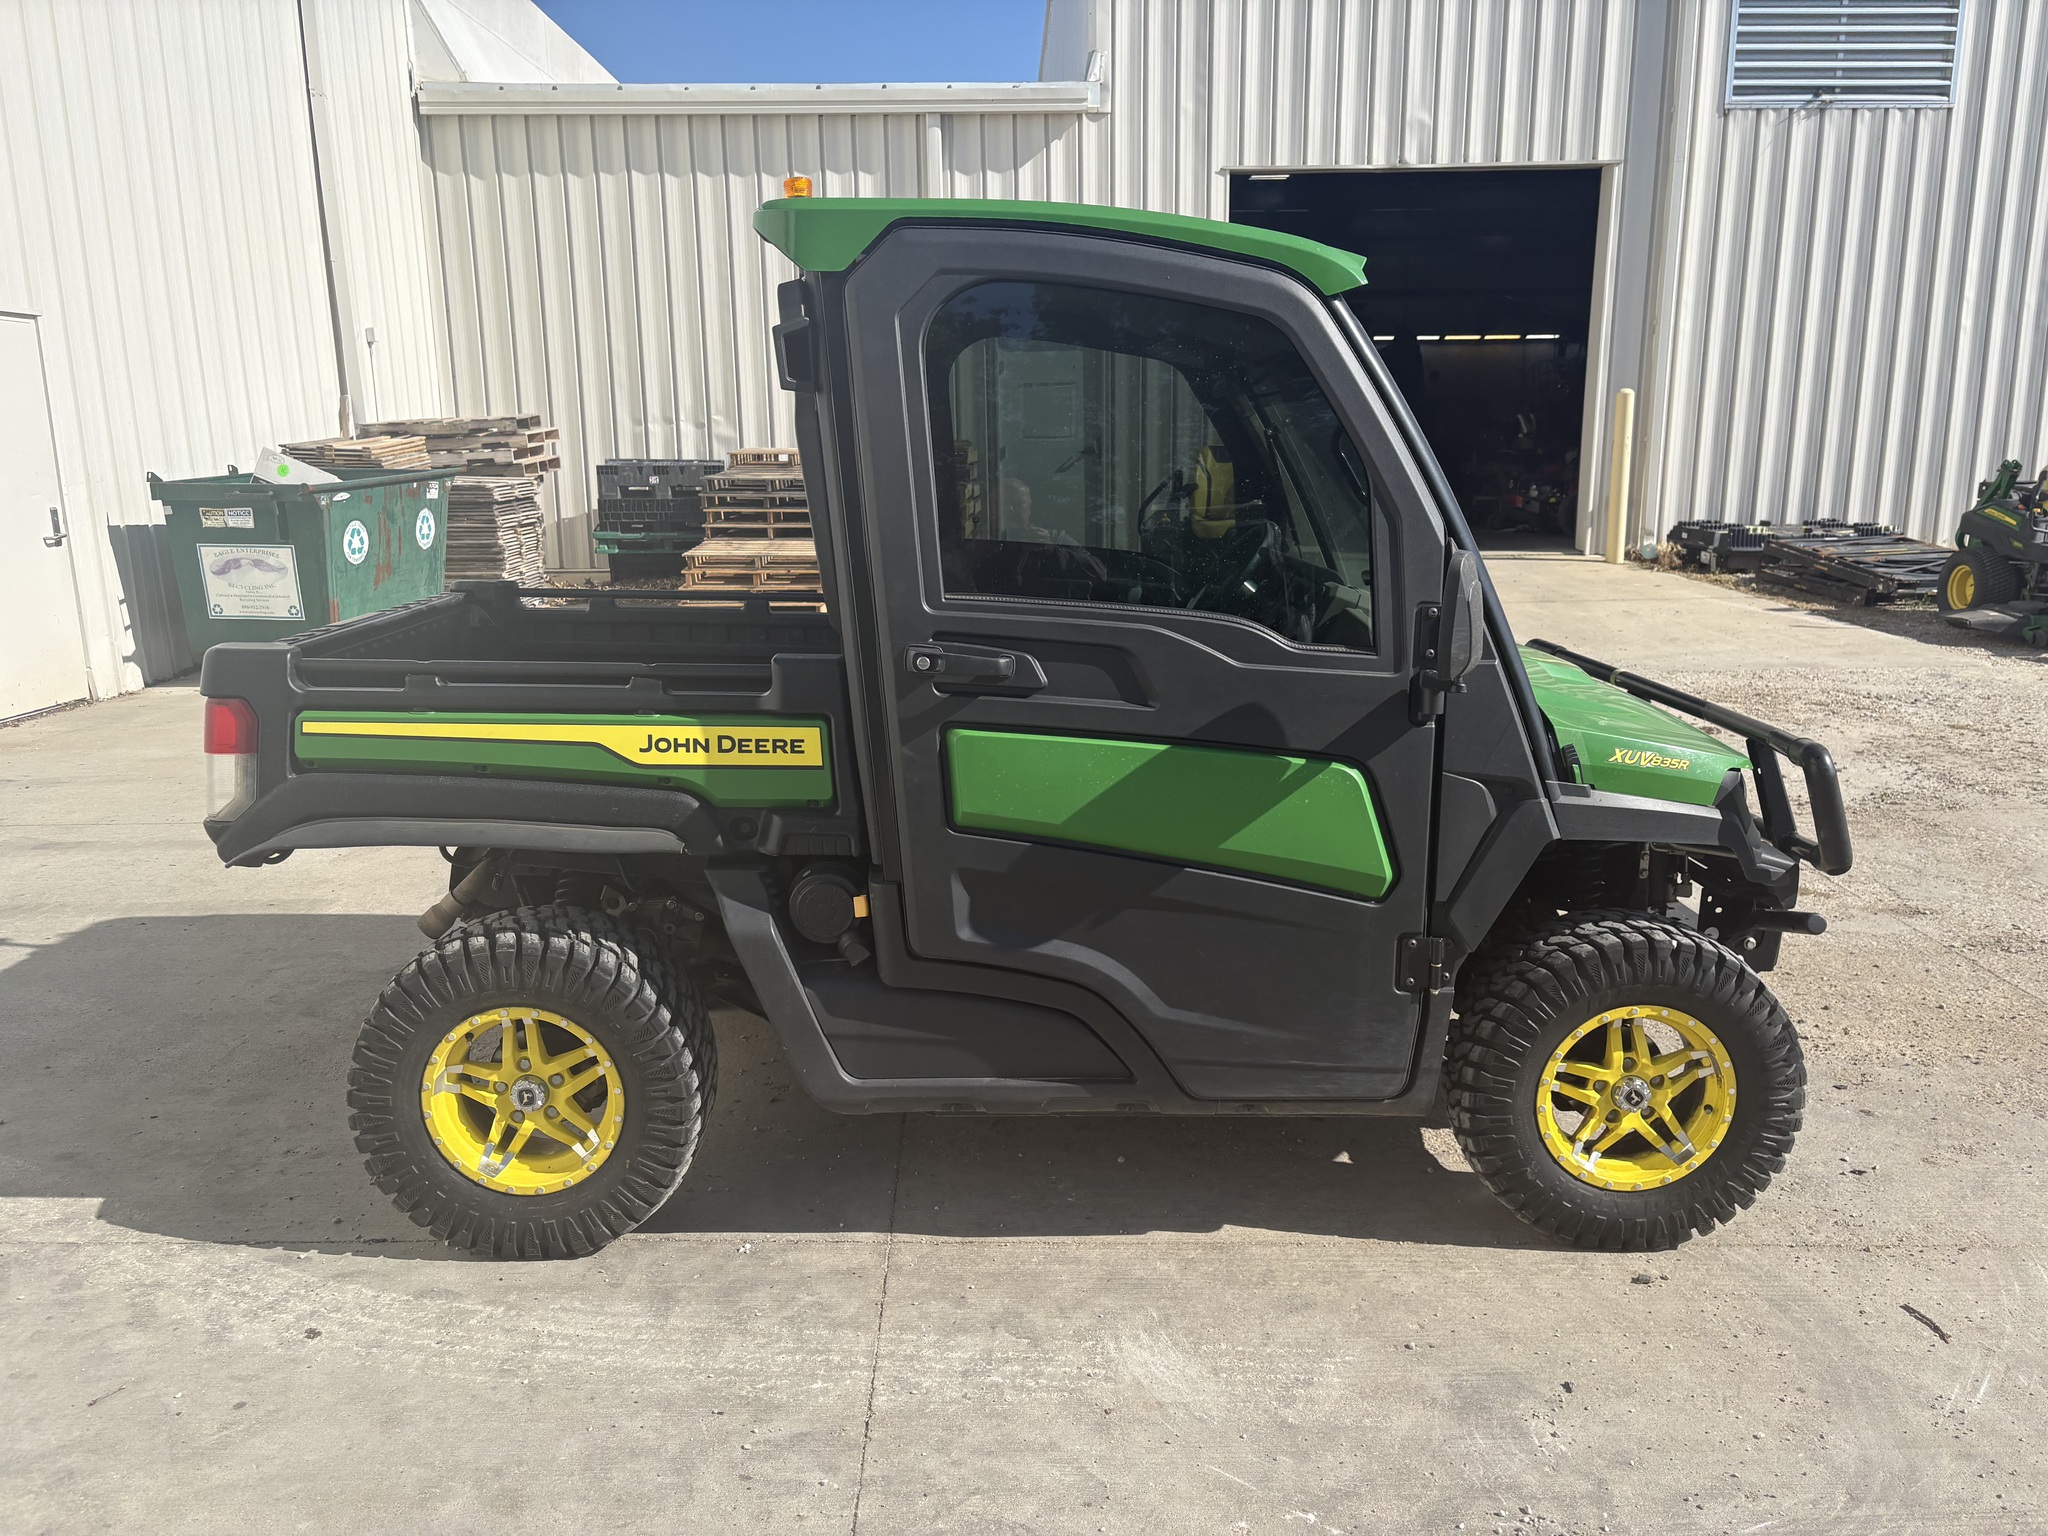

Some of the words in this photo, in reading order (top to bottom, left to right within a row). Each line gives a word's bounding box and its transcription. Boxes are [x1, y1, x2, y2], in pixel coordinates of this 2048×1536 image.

[213, 549, 235, 557] EAGLE
[236, 548, 280, 558] ENTERPRISES
[228, 582, 264, 590] RECYCLING
[639, 734, 710, 753] JOHN
[717, 735, 805, 754] DEERE
[1607, 748, 1690, 770] XUV835R
